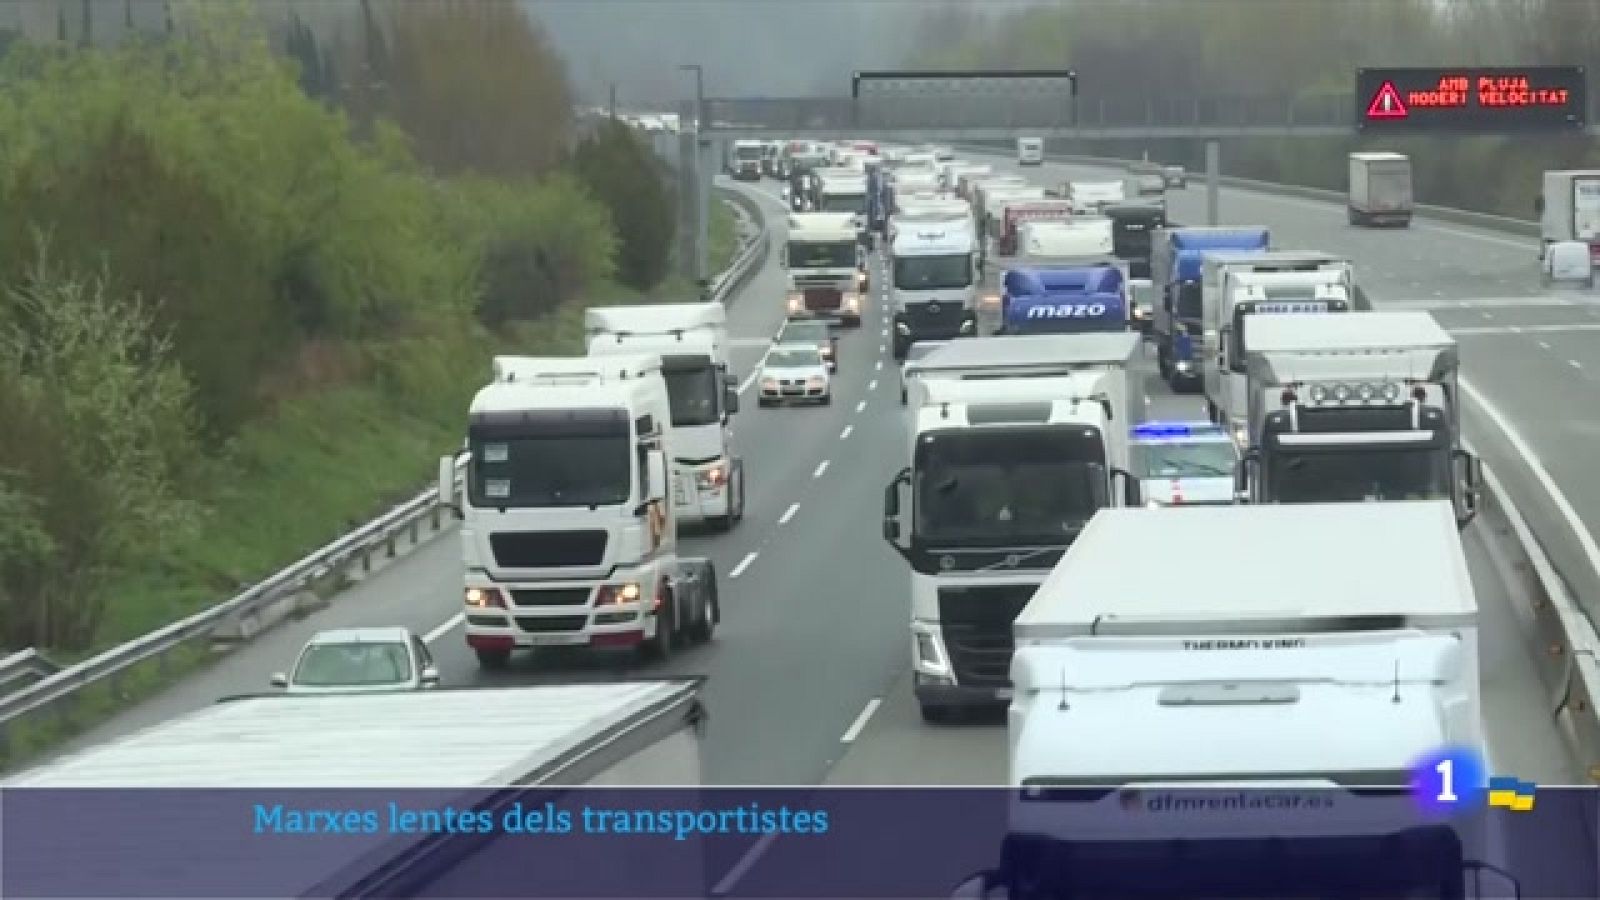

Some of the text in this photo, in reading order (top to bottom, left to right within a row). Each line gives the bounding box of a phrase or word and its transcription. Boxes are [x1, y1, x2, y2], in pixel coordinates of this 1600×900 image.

[1439, 76, 1528, 92] AMB PLUJA
[1480, 89, 1568, 105] VELOCITAT
[1027, 304, 1106, 318] mazo
